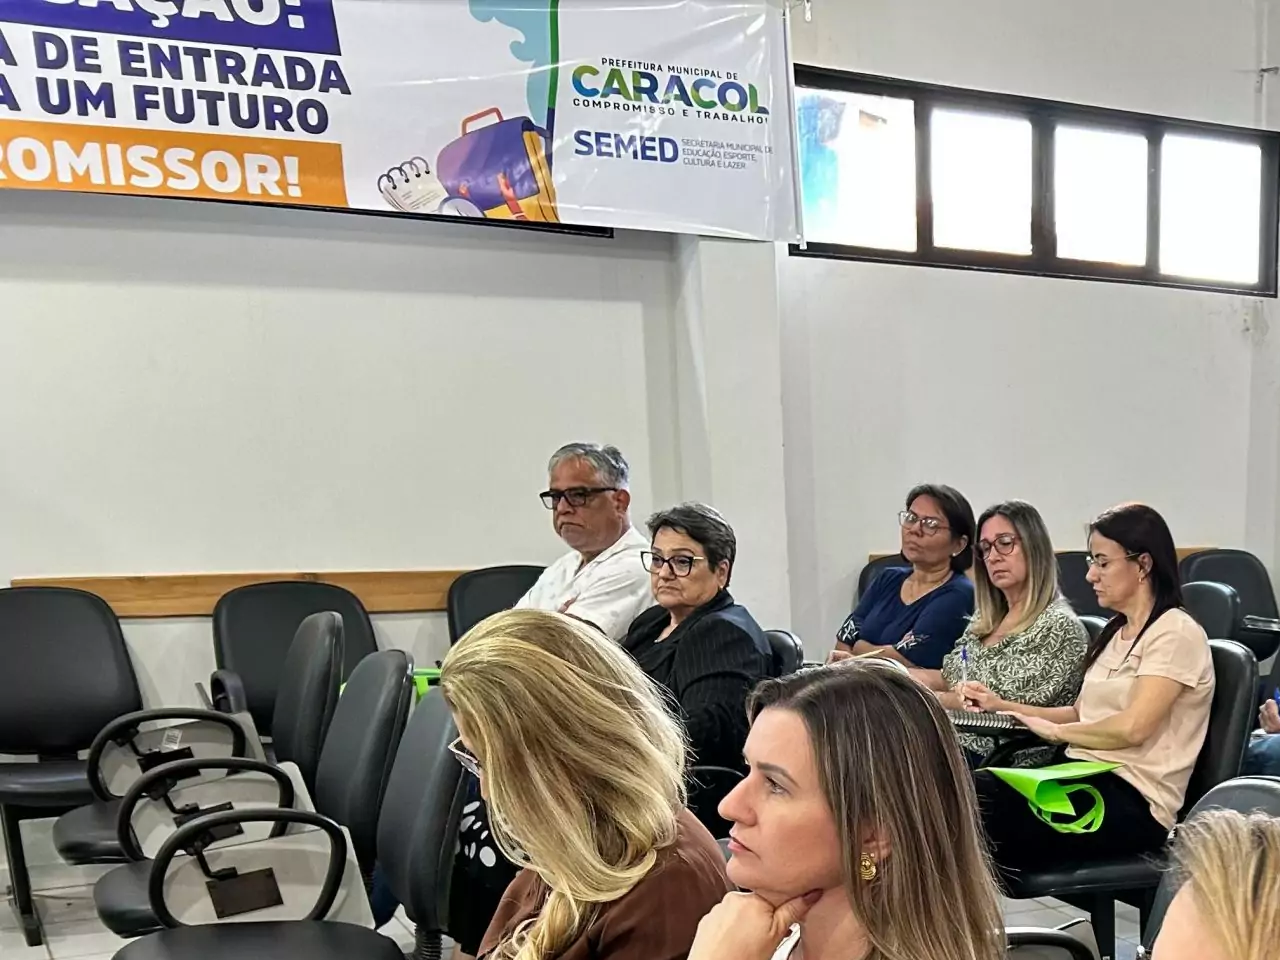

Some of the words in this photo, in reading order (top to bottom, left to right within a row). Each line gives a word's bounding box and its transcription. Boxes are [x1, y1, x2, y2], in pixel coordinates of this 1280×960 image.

[33, 31, 102, 73] DE
[117, 40, 352, 95] ENTRADA
[601, 57, 663, 72] PREFEITURA
[667, 65, 722, 79] MUNICIPAL
[726, 71, 738, 80] DE
[35, 76, 116, 118] UM
[133, 85, 329, 134] FUTURO
[572, 65, 769, 115] CARACOL
[573, 98, 675, 116] COMPROMISSO
[682, 109, 689, 117] E
[573, 130, 679, 163] SEMED
[681, 138, 725, 149] SECRETARIA
[726, 142, 763, 153] MUNICIPAL
[764, 145, 774, 154] DE
[0, 136, 302, 197] OMISSOR!
[683, 158, 716, 168] CULTURA
[723, 161, 746, 170] LAZER
